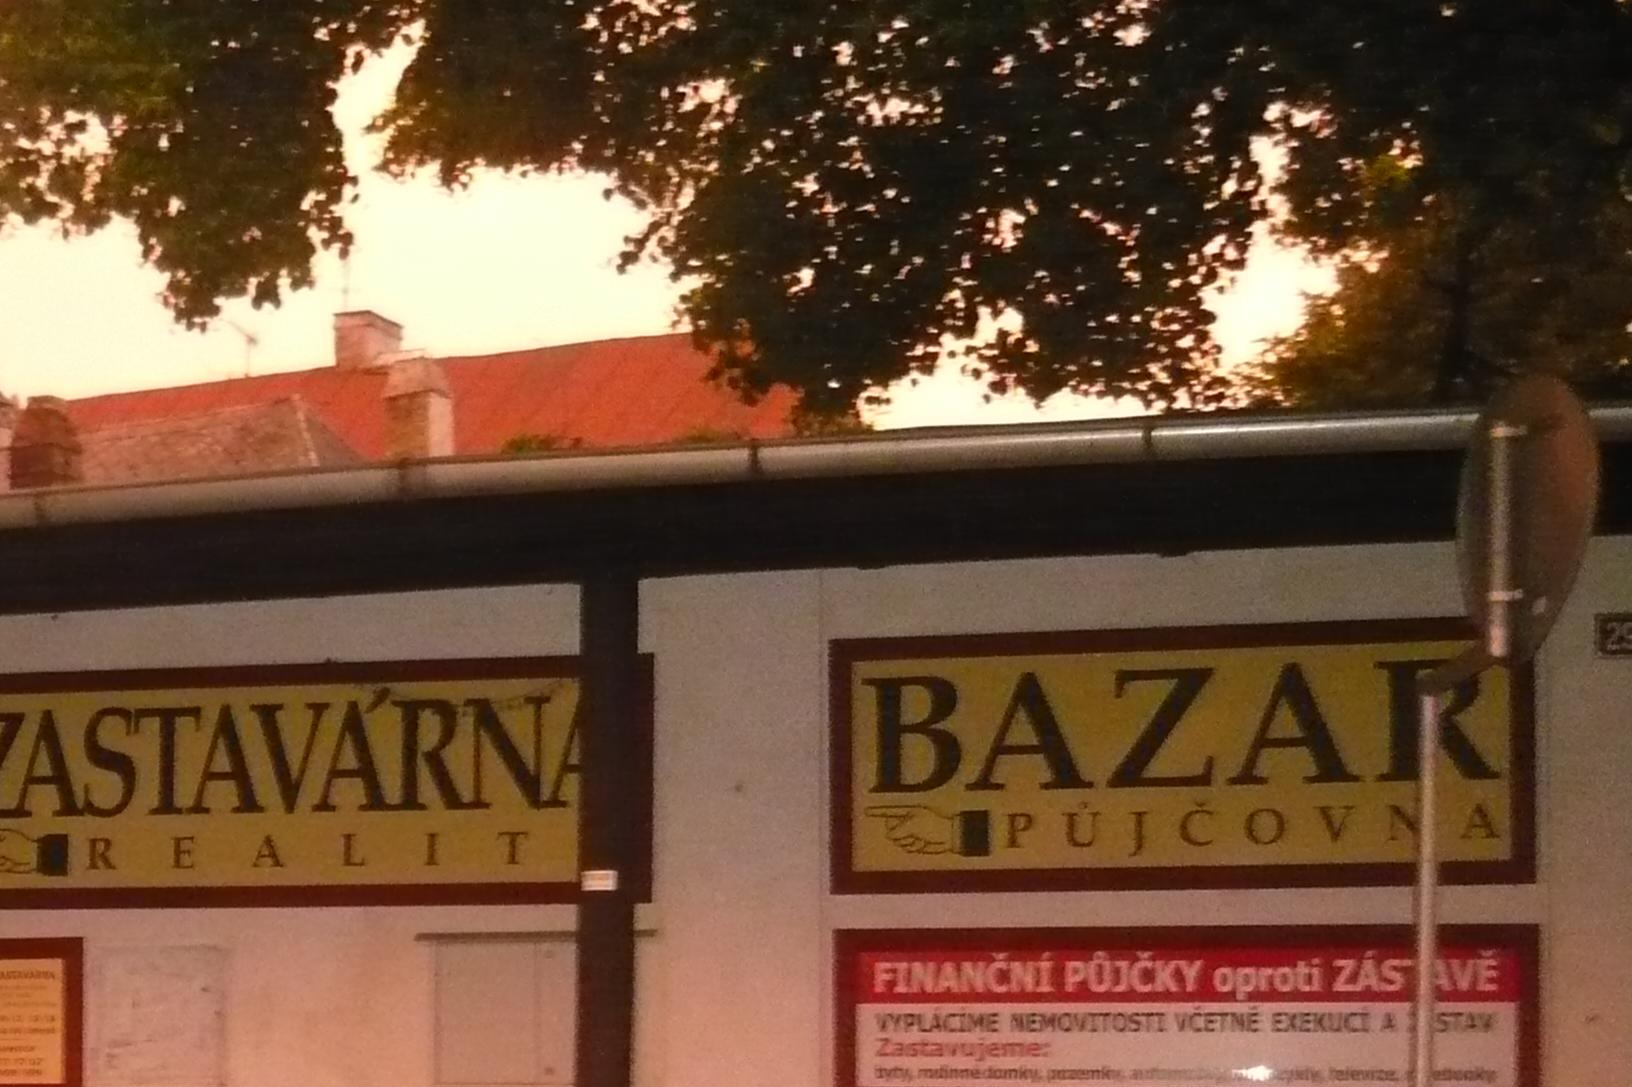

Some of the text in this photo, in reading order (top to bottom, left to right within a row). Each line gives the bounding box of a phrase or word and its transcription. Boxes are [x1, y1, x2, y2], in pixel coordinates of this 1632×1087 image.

[862, 659, 1501, 794] BAZAR
[1006, 799, 1501, 857] PŮJČOVNA
[873, 949, 1499, 1001] FINANČNÍ PŮJČKY oproti ZÁSAVĚ
[1010, 1011, 1167, 1033] NEMOVITOSTI
[1174, 1006, 1261, 1033] VČETNĚ
[875, 1038, 1051, 1062] Zastavujeme:
